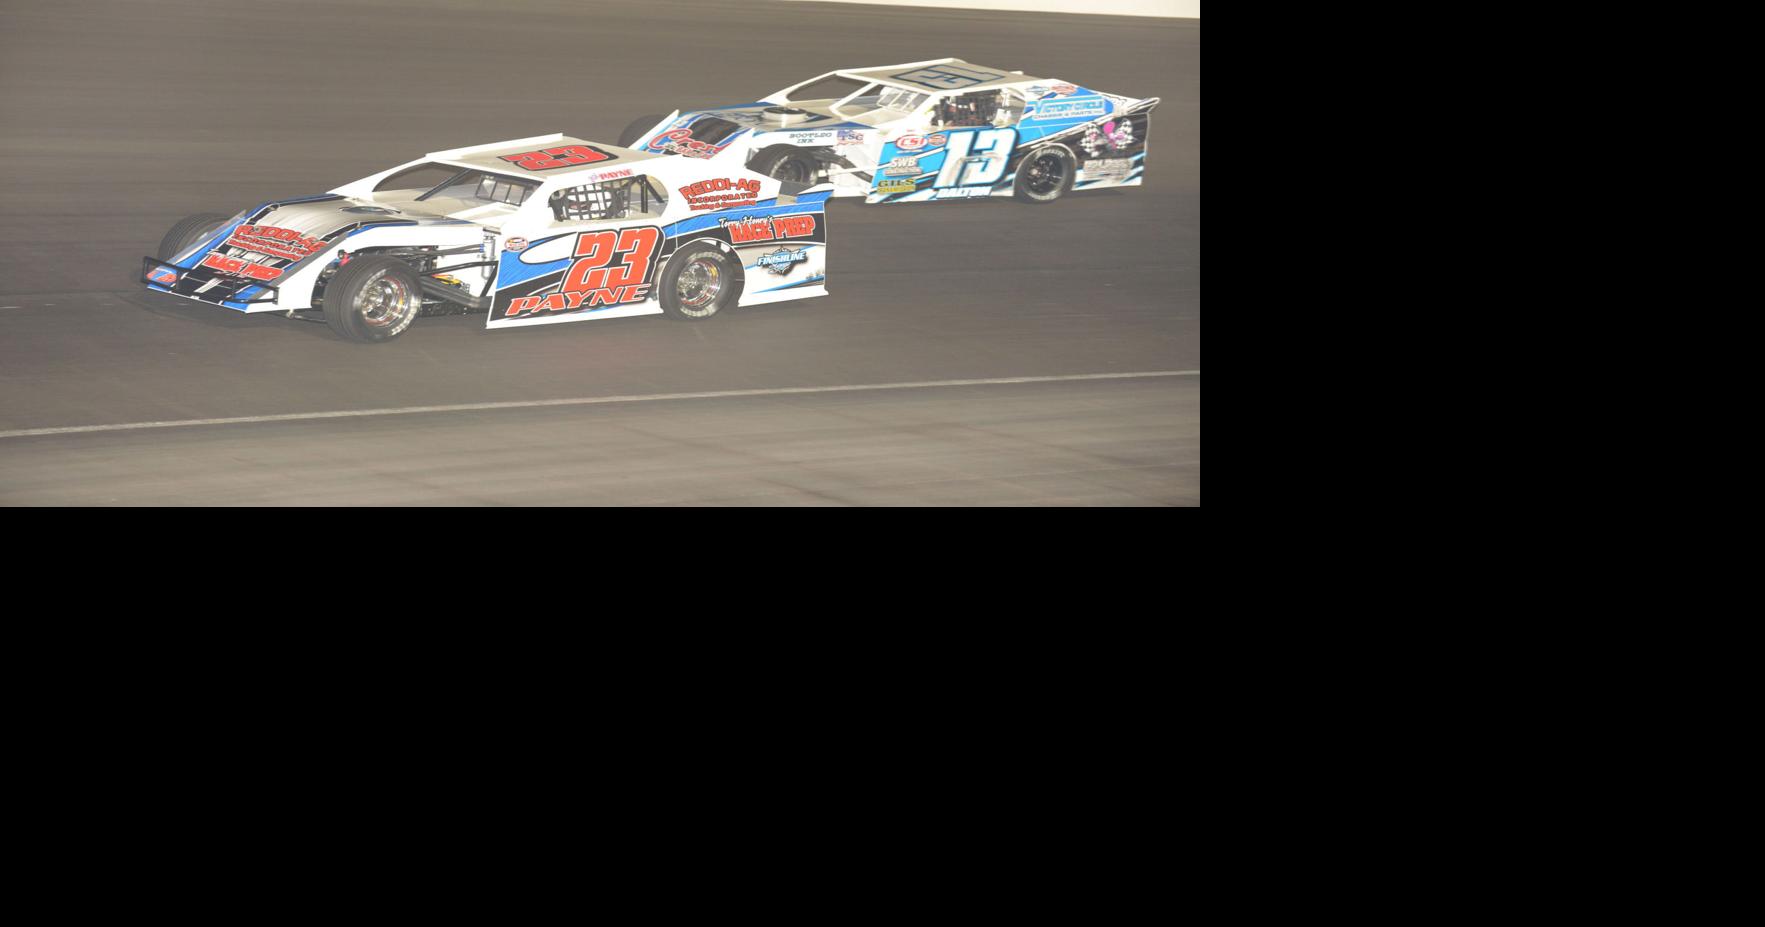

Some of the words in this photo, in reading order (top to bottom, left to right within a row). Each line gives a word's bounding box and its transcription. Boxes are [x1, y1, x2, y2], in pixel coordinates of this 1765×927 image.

[497, 145, 619, 171] 23
[890, 156, 917, 168] SWB
[933, 127, 1019, 188] 13
[600, 169, 633, 181] PAYNE
[678, 178, 761, 200] REDDI-AG
[687, 191, 759, 205] INCORPORATED
[772, 214, 816, 240] PREP
[557, 225, 665, 293] 23
[757, 251, 807, 266] FINISHLINE
[504, 283, 652, 317] PAYNE
